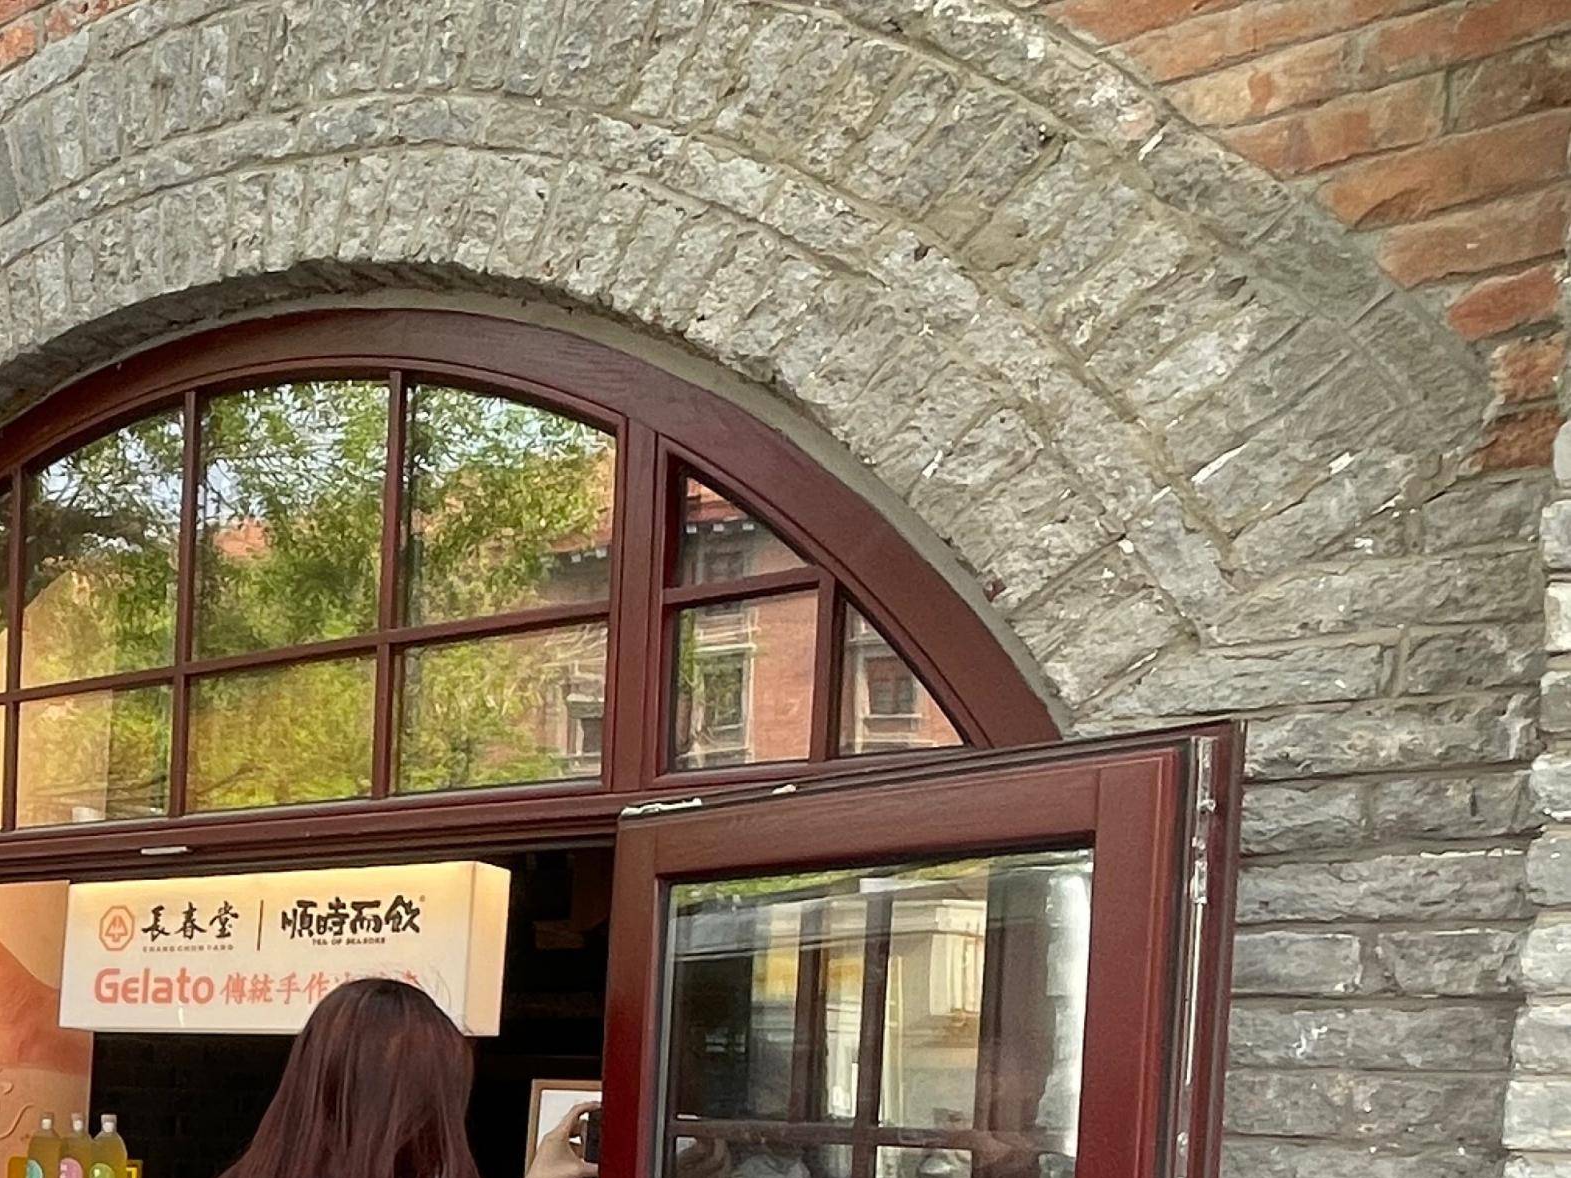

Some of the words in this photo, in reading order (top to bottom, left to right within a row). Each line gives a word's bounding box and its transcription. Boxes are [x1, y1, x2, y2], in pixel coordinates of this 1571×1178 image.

[141, 901, 239, 941] 長春堂
[281, 895, 420, 939] 順時而飲
[94, 966, 215, 1005] Gelato
